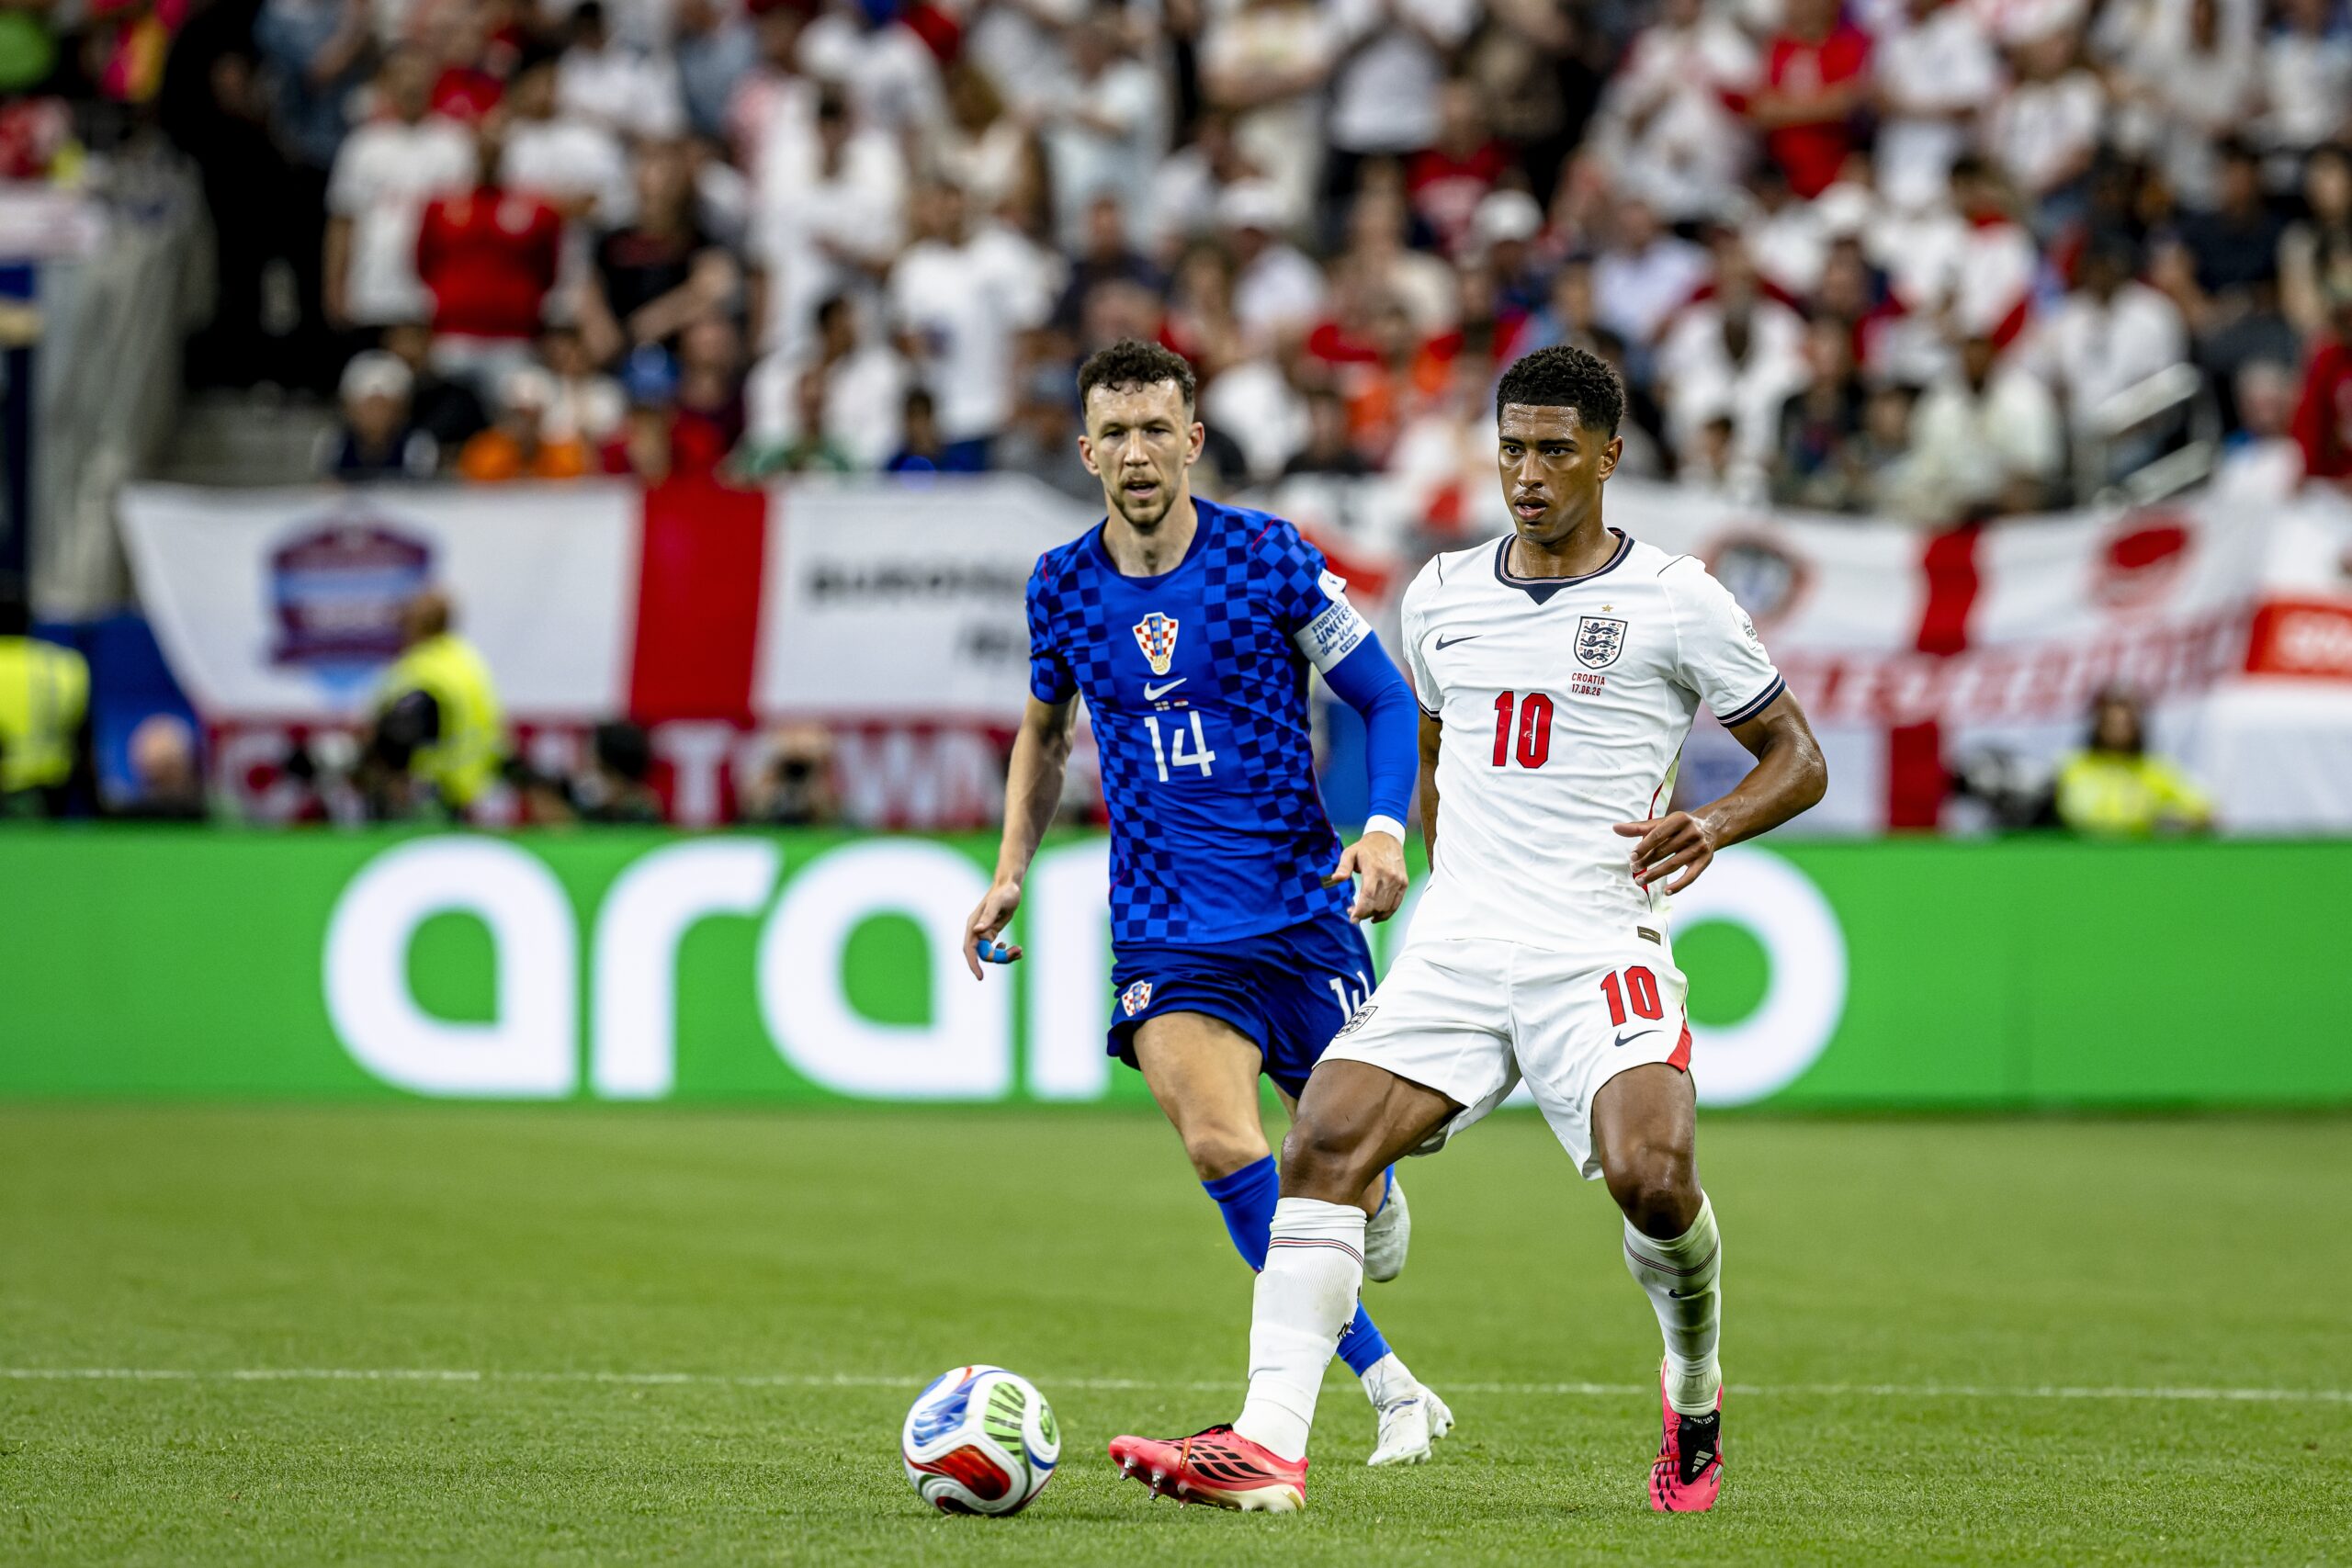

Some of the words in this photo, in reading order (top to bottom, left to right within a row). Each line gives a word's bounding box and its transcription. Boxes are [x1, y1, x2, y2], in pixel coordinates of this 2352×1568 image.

[1317, 606, 1351, 645] UNITES
[1320, 640, 1339, 656] the
[1572, 672, 1605, 685] CROATIA
[1572, 683, 1601, 696] 17.06.26
[1144, 711, 1216, 783] 14
[1492, 690, 1554, 769] 10
[322, 835, 1849, 1106] arao
[1600, 965, 1664, 1027] 10
